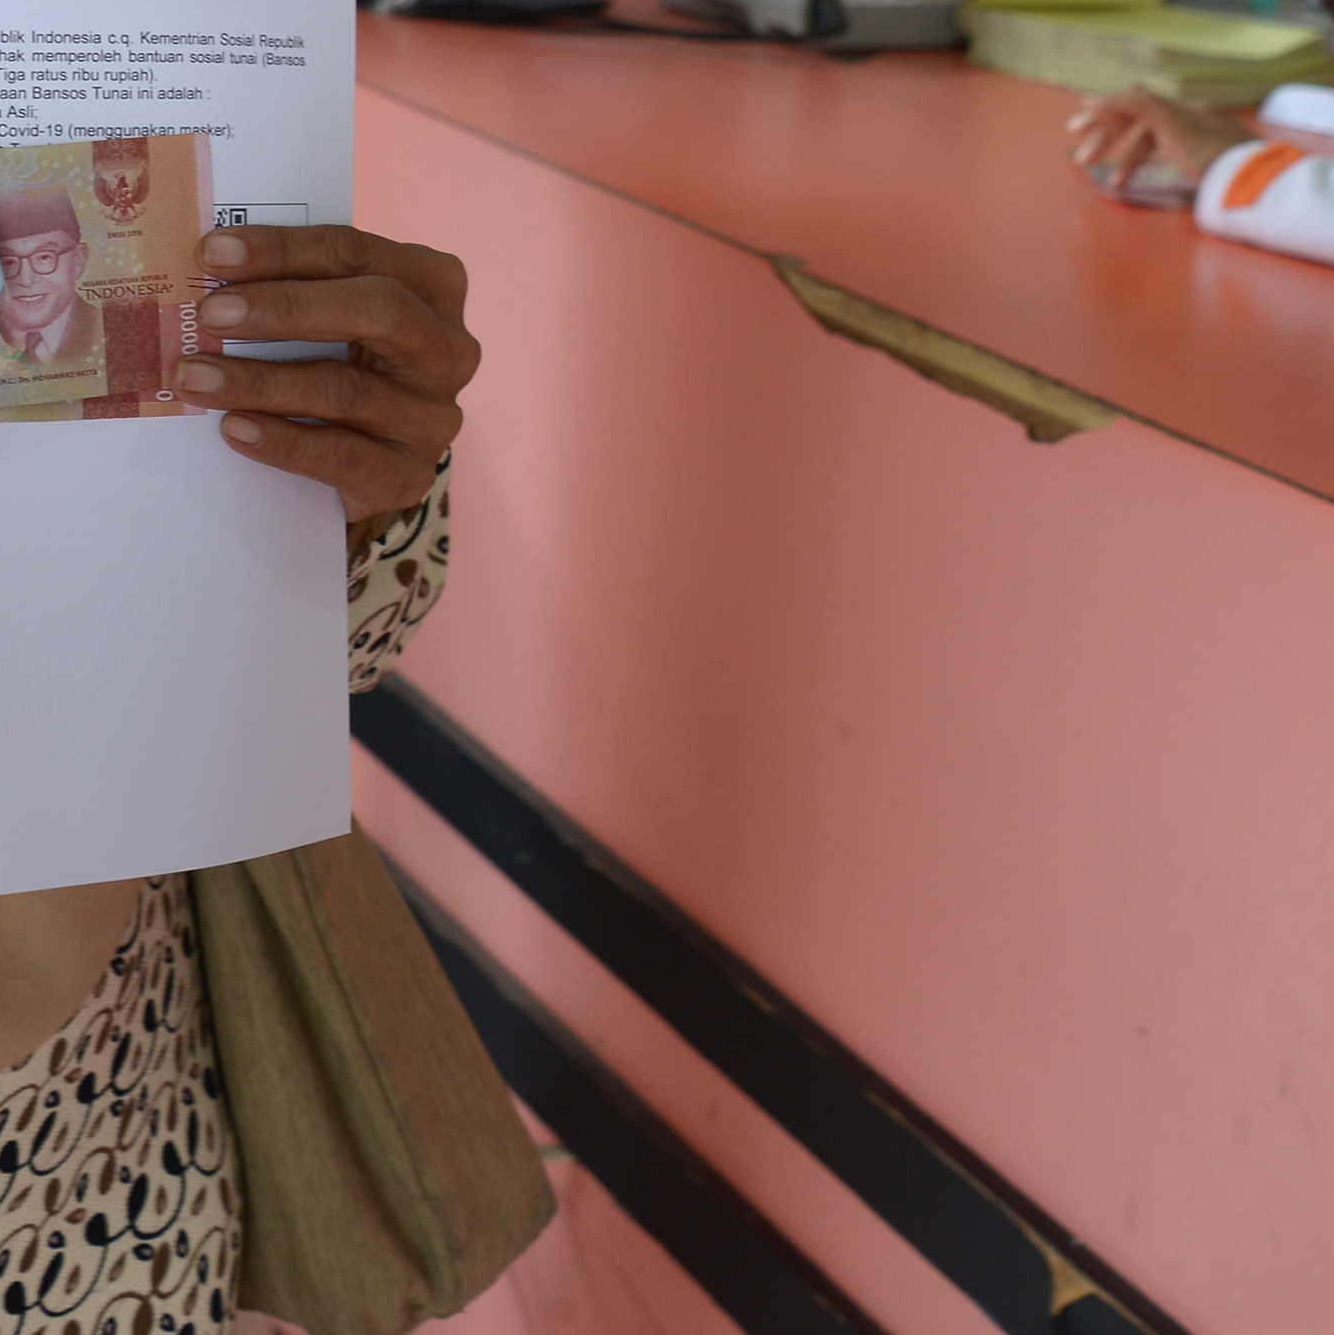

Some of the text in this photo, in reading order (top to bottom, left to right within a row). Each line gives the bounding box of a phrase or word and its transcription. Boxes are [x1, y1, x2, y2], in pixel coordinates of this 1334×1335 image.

[32, 31, 101, 46] Indonesia
[107, 34, 133, 49] c.q.
[140, 32, 215, 47] Kementrian
[220, 33, 255, 47] Sosial
[259, 34, 306, 50] Republik
[32, 49, 122, 65] memperoleh
[128, 49, 184, 64] bantuan
[189, 50, 225, 65] sosial
[229, 52, 258, 66] tunai
[261, 52, 306, 68] (Bansos
[30, 69, 68, 82] ratus
[71, 68, 100, 82] ribu
[104, 68, 158, 85] rupiah).
[32, 86, 87, 100] Bansos
[92, 86, 133, 100] Tunai
[137, 86, 154, 100] ini
[158, 87, 203, 101] adalah
[6, 105, 38, 121] Asli;
[67, 124, 175, 141] (menggunakan
[180, 124, 235, 139] masker);
[80, 283, 173, 301] INDONESIA
[179, 299, 199, 355] 10000
